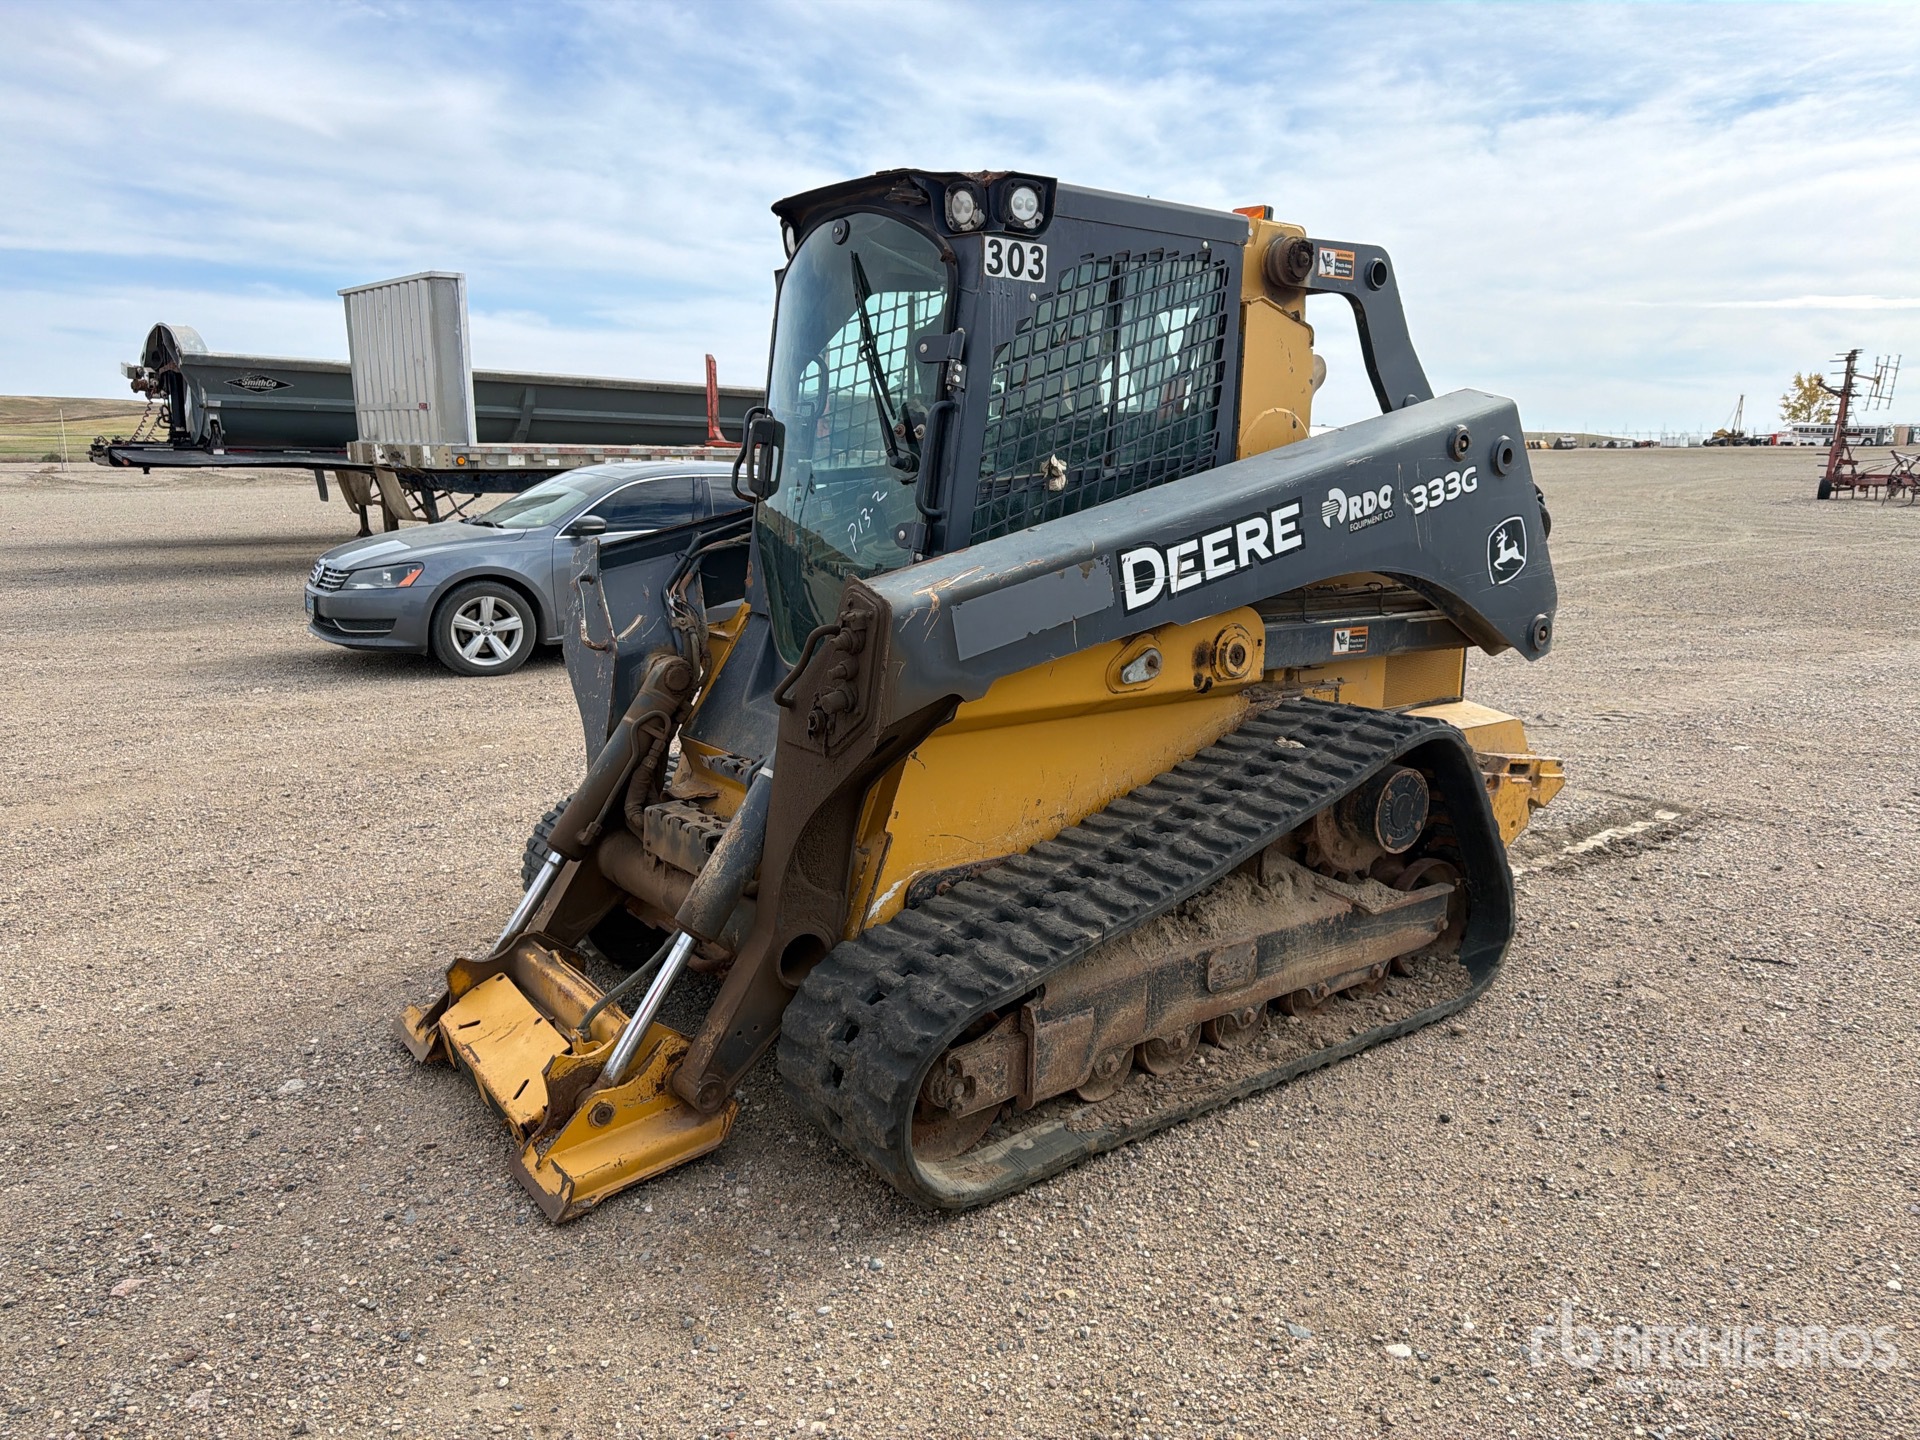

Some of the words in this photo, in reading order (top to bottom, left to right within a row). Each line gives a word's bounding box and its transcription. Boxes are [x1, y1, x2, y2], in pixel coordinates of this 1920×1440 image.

[986, 239, 1045, 281] 303
[241, 378, 277, 387] SmithCo
[1411, 466, 1478, 515] 333G
[1349, 513, 1383, 532] EQUIPMENT
[1383, 509, 1395, 519] CO.
[1121, 502, 1302, 611] DEERE
